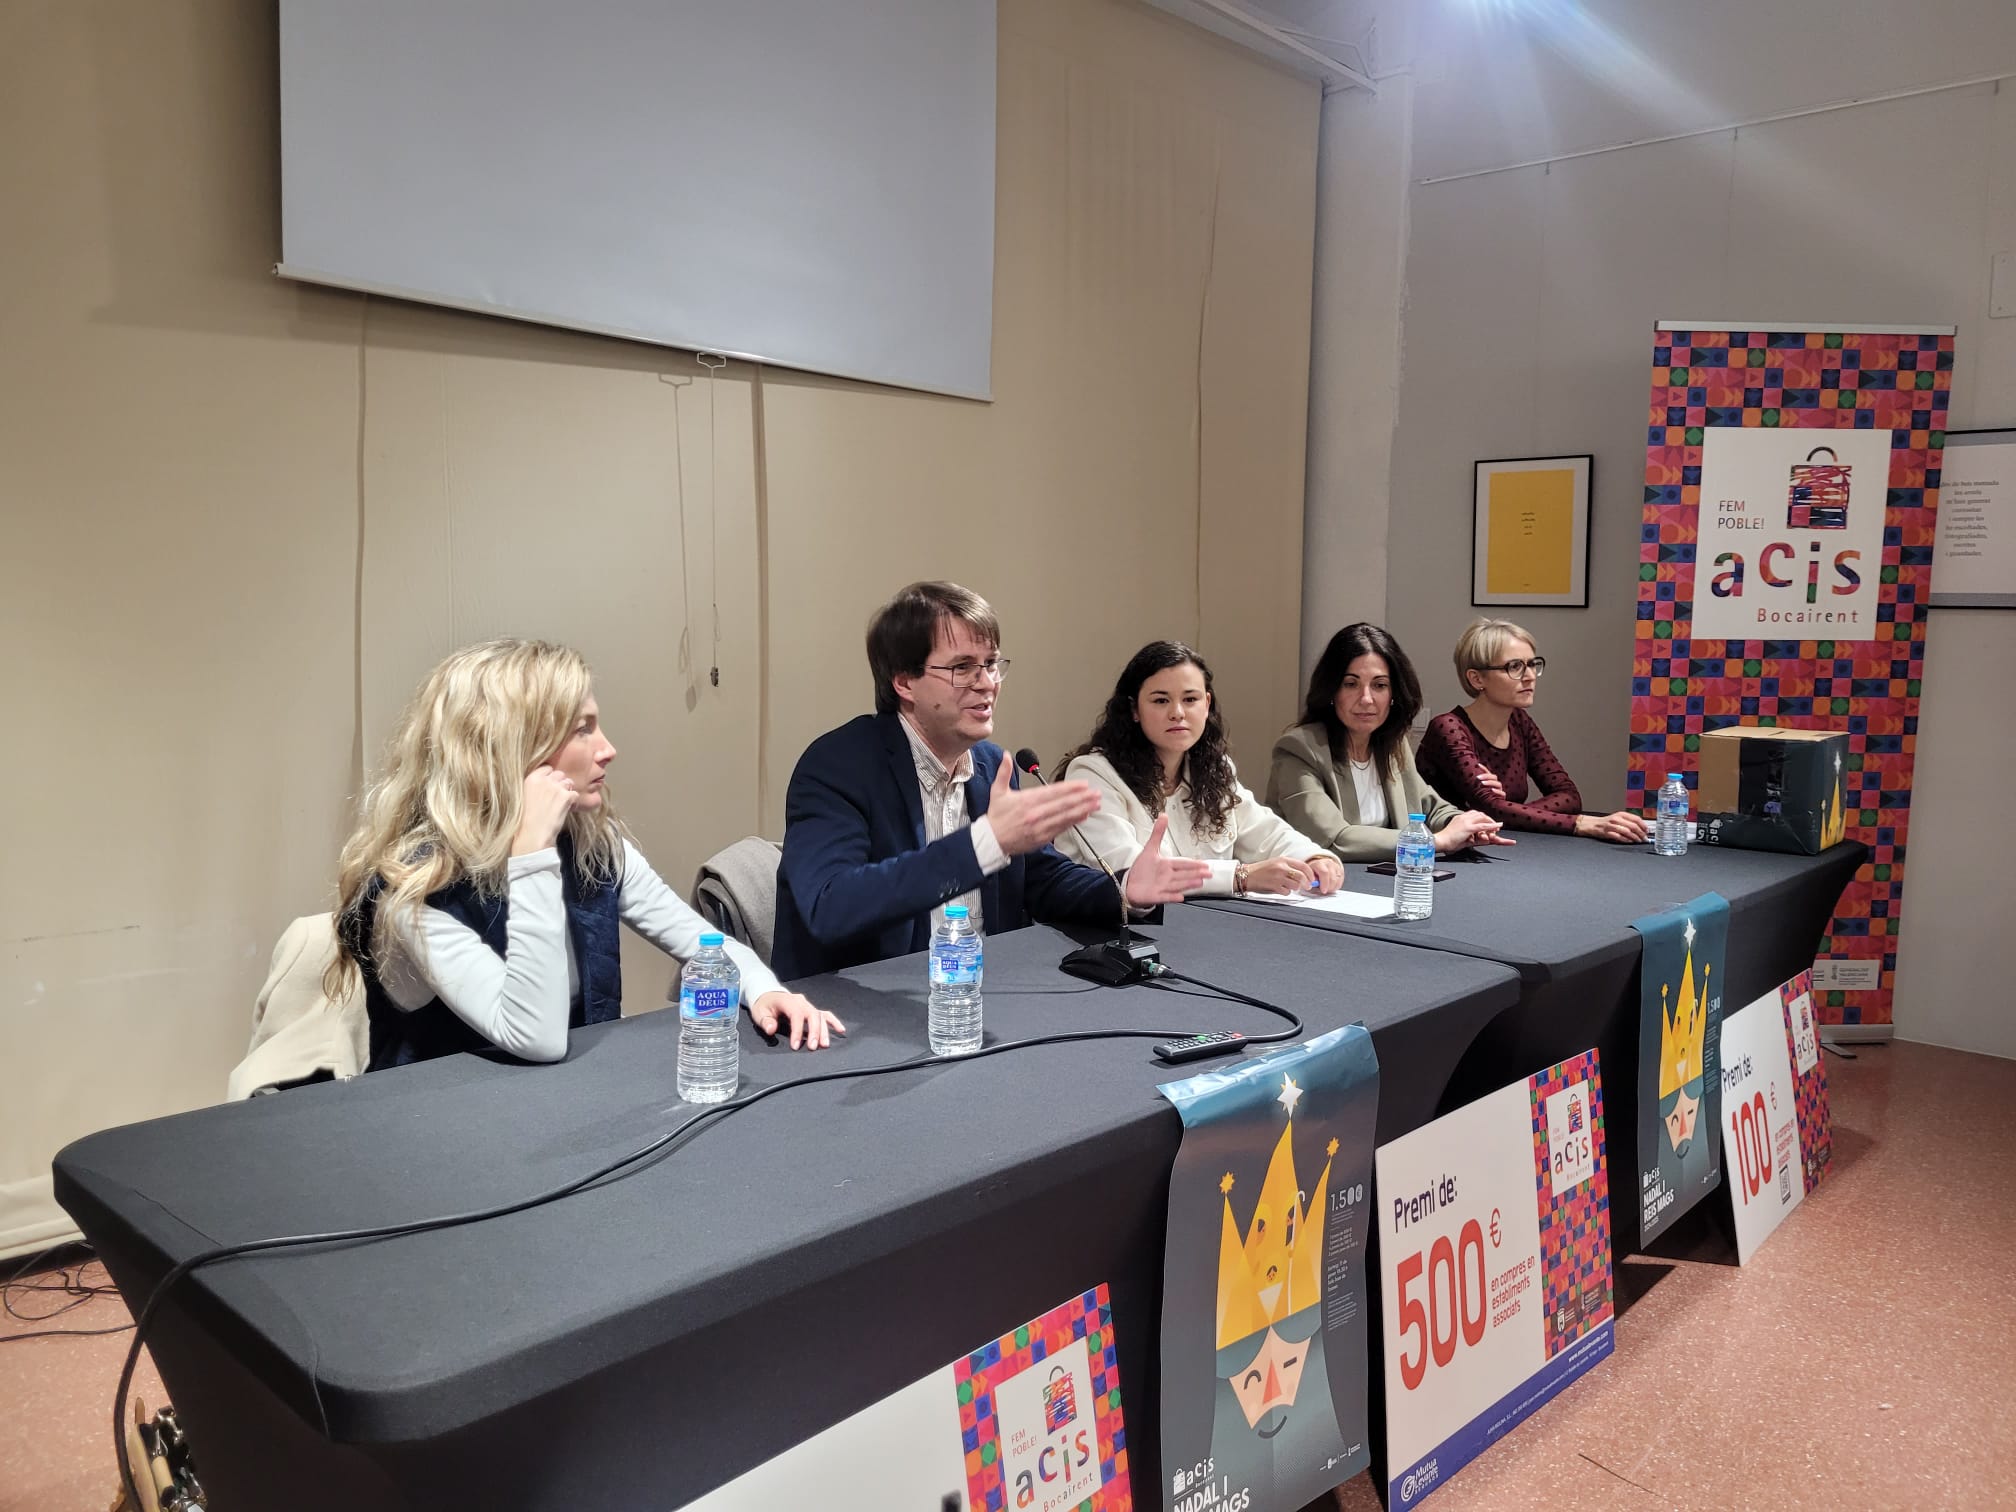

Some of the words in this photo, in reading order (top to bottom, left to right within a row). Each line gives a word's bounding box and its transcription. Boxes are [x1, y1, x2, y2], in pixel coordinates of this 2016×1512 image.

[1719, 500, 1745, 512] FEM
[1718, 517, 1765, 530] POBLE!
[1711, 541, 1861, 604] acis
[1757, 608, 1859, 623] Bocairent
[697, 991, 727, 1000] AQUA
[698, 999, 726, 1007] DEUS
[1722, 1057, 1743, 1093] Premi
[1555, 1136, 1589, 1175] acis
[1732, 1091, 1772, 1206] 100
[1330, 1183, 1363, 1211] 1.500
[1394, 1179, 1436, 1233] Premi
[1439, 1173, 1458, 1208] de:
[1491, 1277, 1499, 1292] en
[1500, 1260, 1526, 1287] compres
[1527, 1255, 1536, 1269] en
[1397, 1218, 1487, 1390] 500
[1489, 1207, 1502, 1248] €
[1492, 1275, 1531, 1310] establiments
[1493, 1299, 1521, 1328] associats
[1011, 1428, 1026, 1445] FEM
[1012, 1435, 1037, 1458] POBLE!
[1016, 1429, 1090, 1508] acis
[1186, 1457, 1214, 1486] acis
[1415, 1458, 1437, 1480] Mutua
[1043, 1472, 1094, 1512] Bocairent
[1223, 1475, 1228, 1497] I
